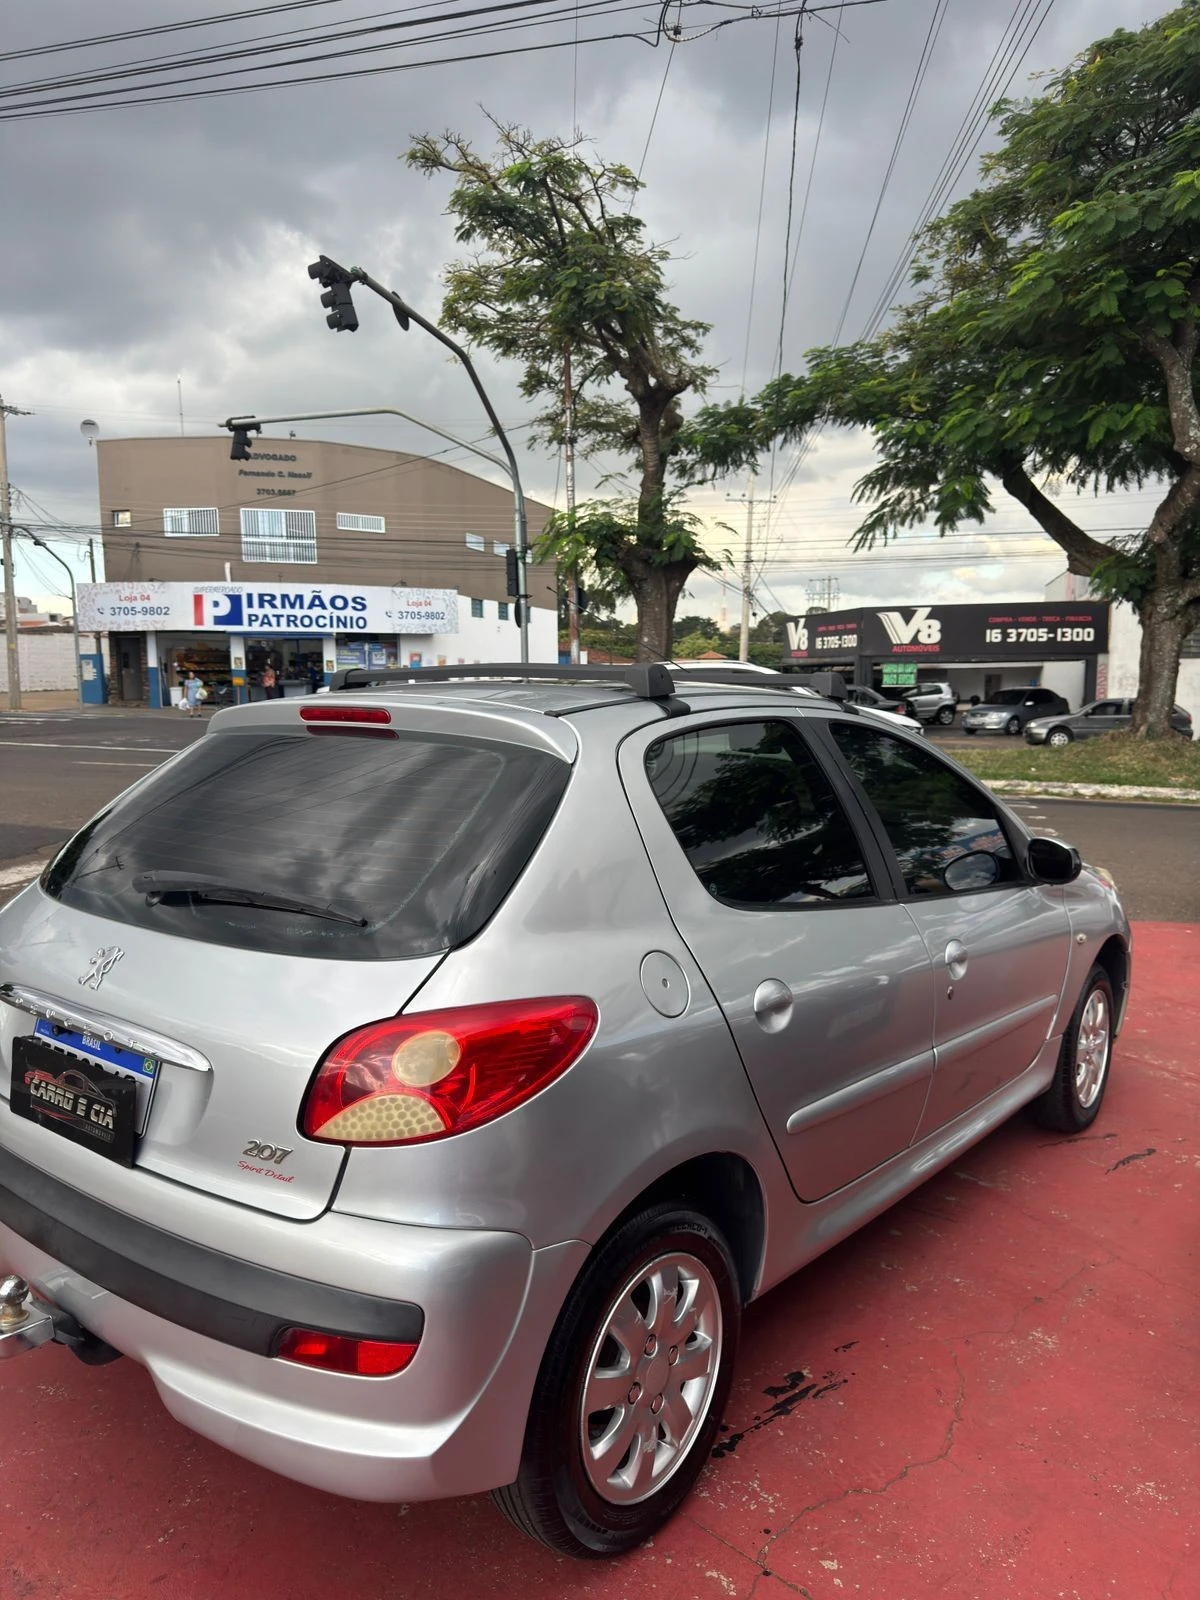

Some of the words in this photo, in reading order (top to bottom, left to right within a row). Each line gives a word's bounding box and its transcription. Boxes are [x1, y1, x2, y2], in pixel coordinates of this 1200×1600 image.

[251, 453, 297, 462] DVOGADO
[119, 594, 138, 603] Loja
[140, 594, 151, 602] 04
[246, 590, 368, 612] IRMÃOS
[109, 606, 171, 616] 3705-9802
[398, 610, 445, 621] 3705-9802
[247, 612, 368, 630] PATROCÍNIO
[876, 607, 942, 645] V8
[786, 617, 809, 651] V8
[985, 628, 1002, 643] 16
[1006, 627, 1095, 642] 3705-1300
[82, 1035, 101, 1051] BRASIL
[30, 1075, 75, 1111] CARRO
[76, 1096, 88, 1117] E
[90, 1103, 114, 1130] CIA
[242, 1139, 294, 1165] 207
